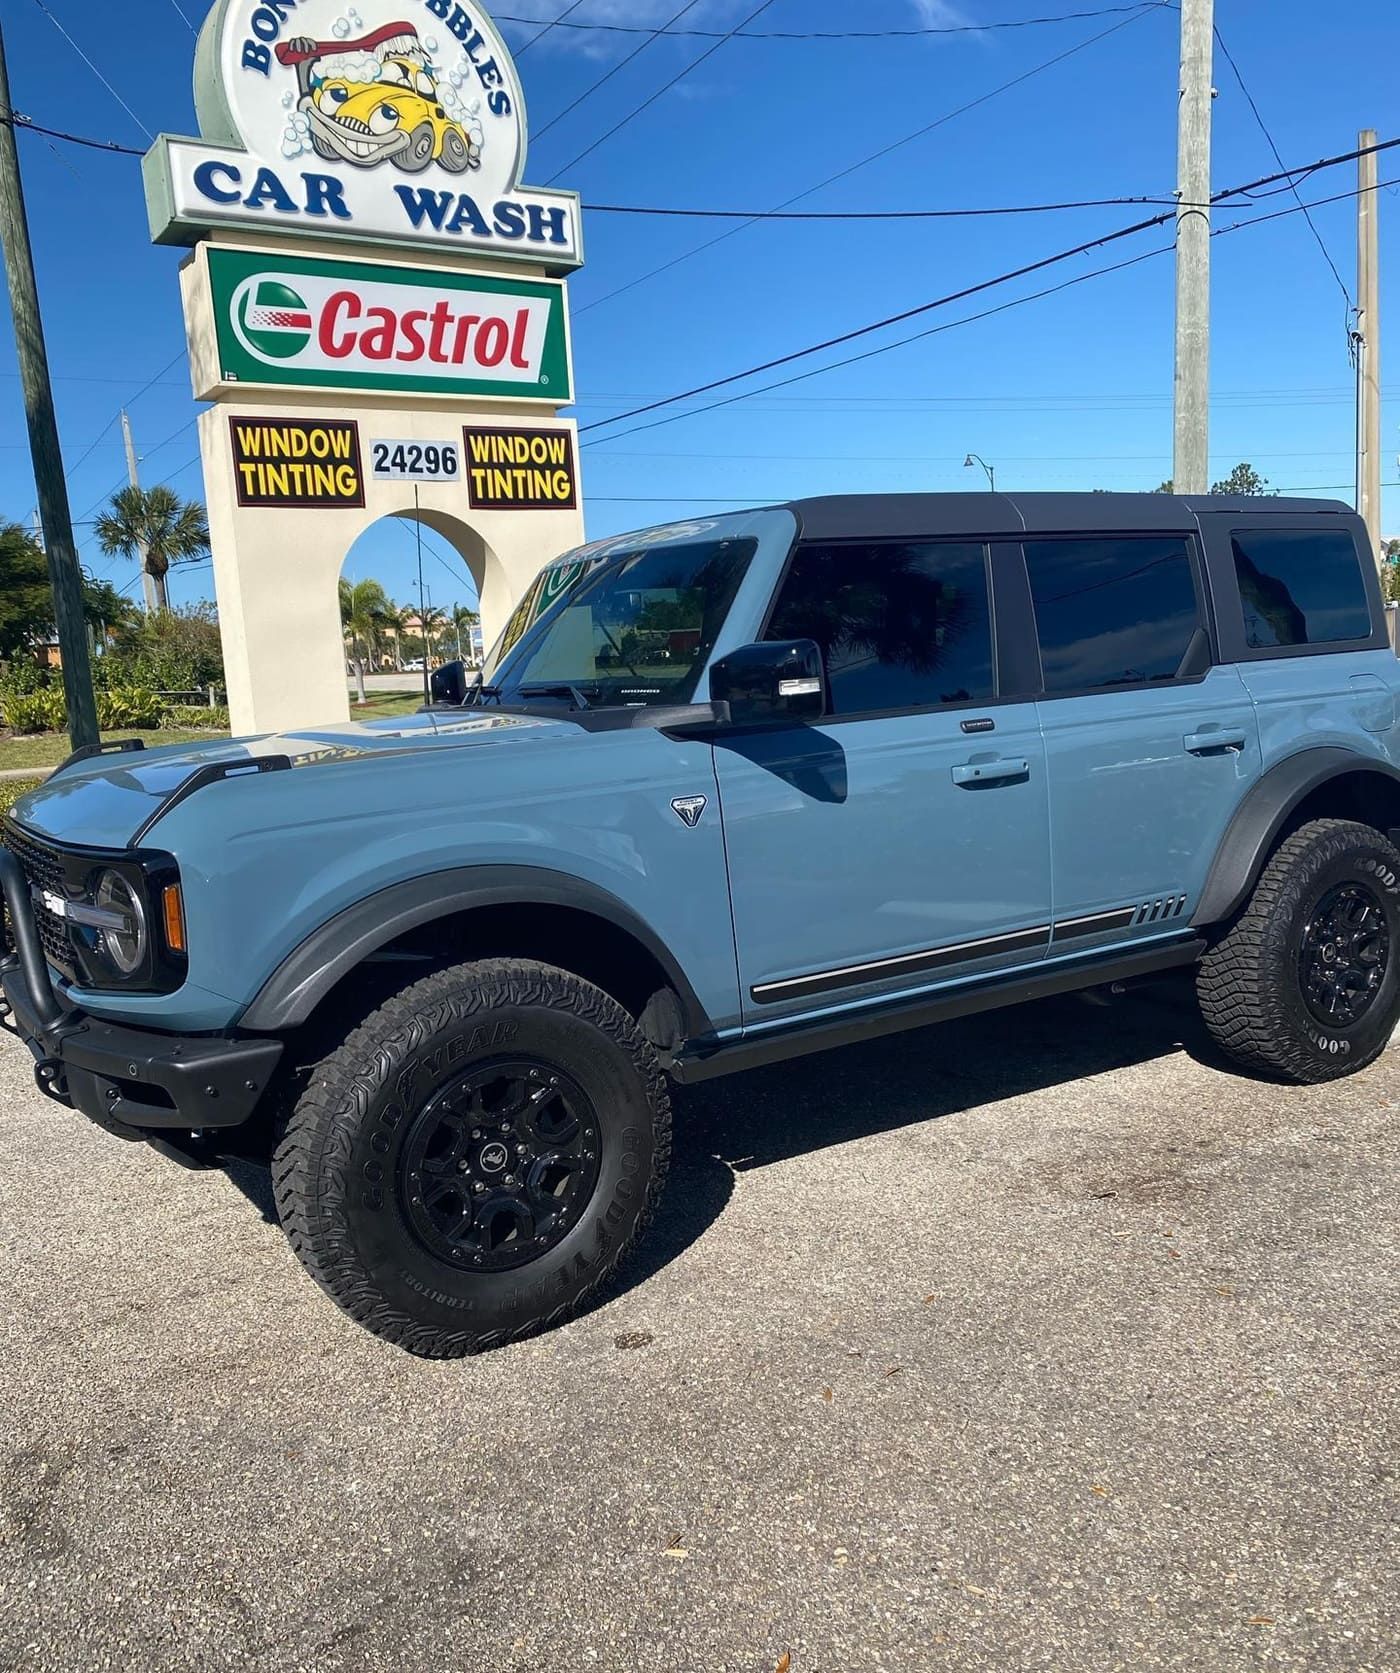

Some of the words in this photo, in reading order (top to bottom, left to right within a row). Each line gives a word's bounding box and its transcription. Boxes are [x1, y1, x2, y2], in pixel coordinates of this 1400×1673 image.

[193, 160, 352, 219] CAR
[393, 184, 568, 244] WASH
[318, 290, 529, 369] Castrol
[236, 425, 353, 460] WINDOW
[373, 443, 458, 476] 24296
[469, 434, 566, 465] WINDOW
[240, 462, 358, 497] TINTING
[471, 468, 572, 500] TINTING
